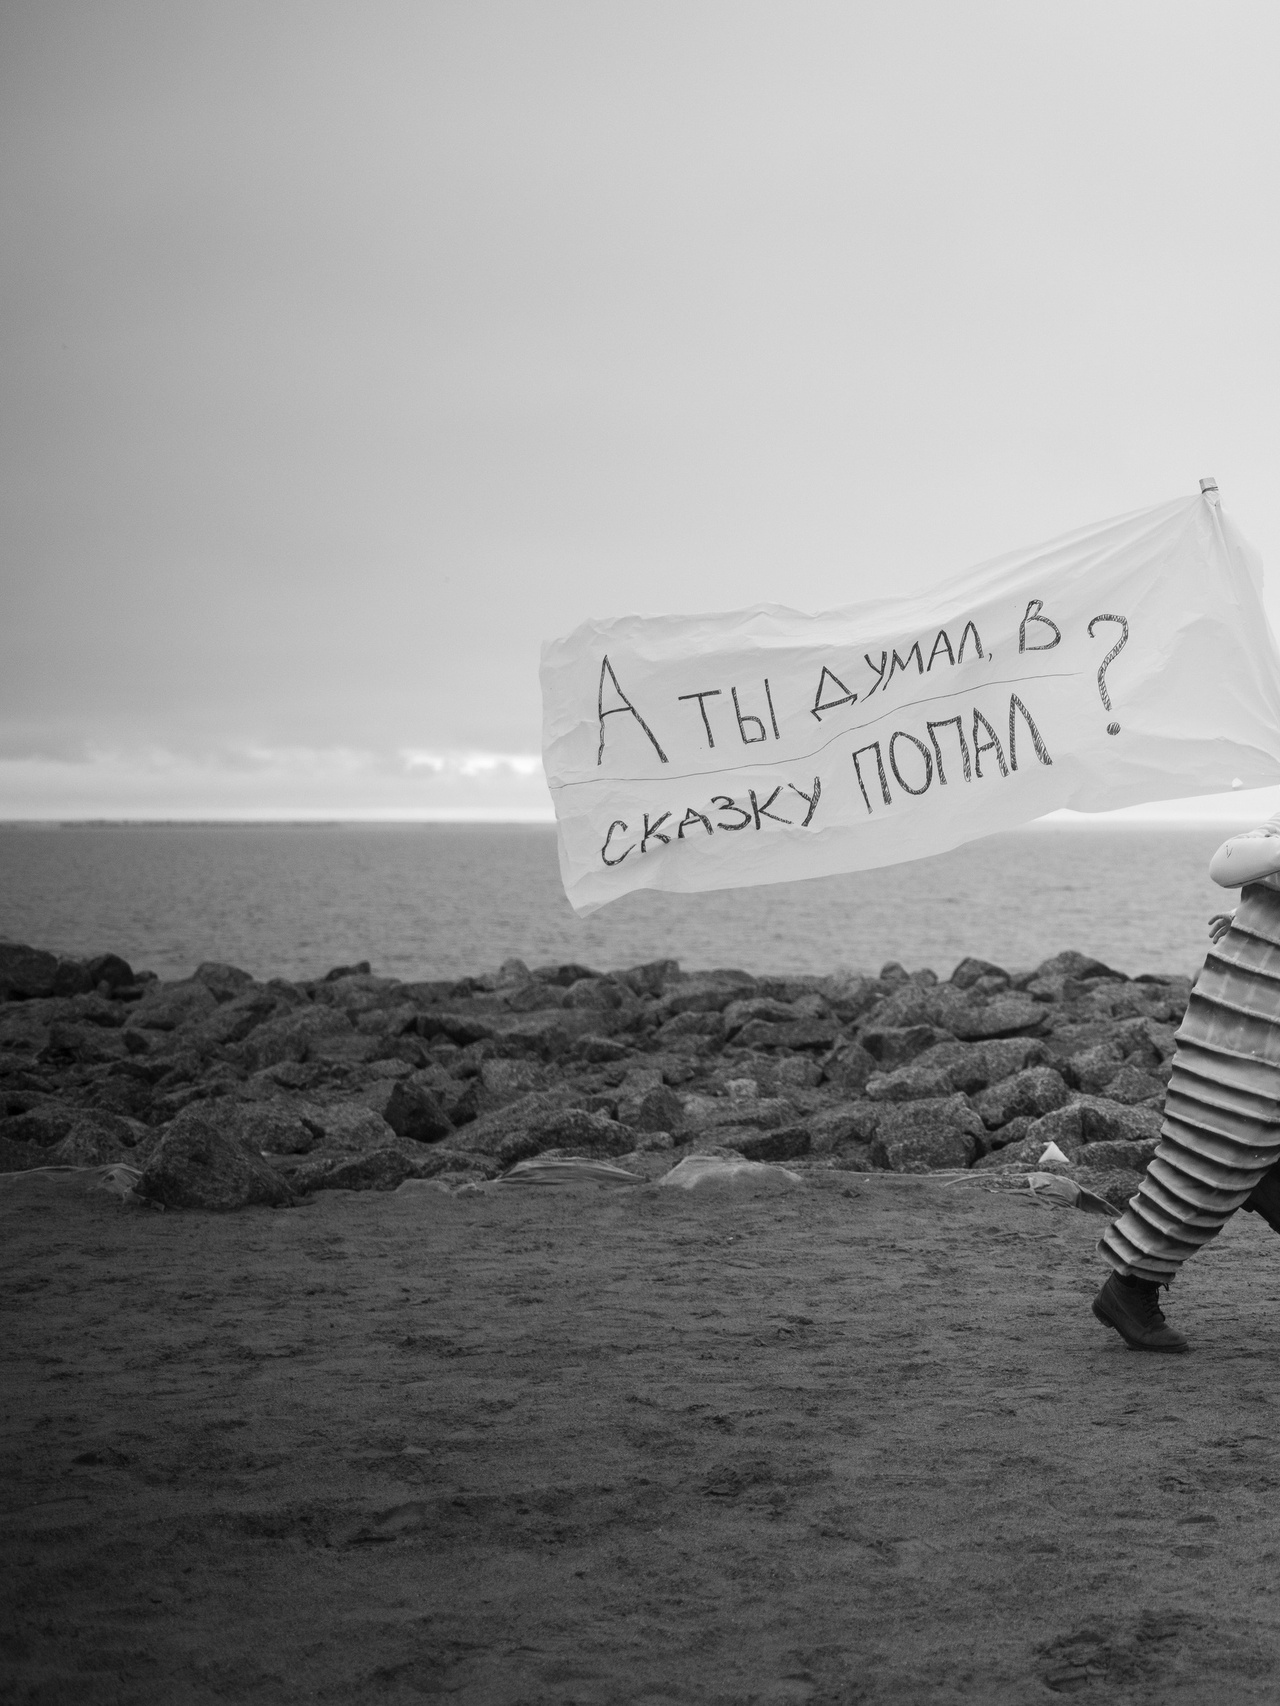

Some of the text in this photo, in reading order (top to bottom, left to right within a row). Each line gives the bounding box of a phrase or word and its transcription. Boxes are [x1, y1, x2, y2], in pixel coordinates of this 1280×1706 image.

[597, 599, 1062, 766] А ТЫ ДУМАЛ, В
[601, 613, 1130, 867] СКАЗКУ ПОПАЛ ?
